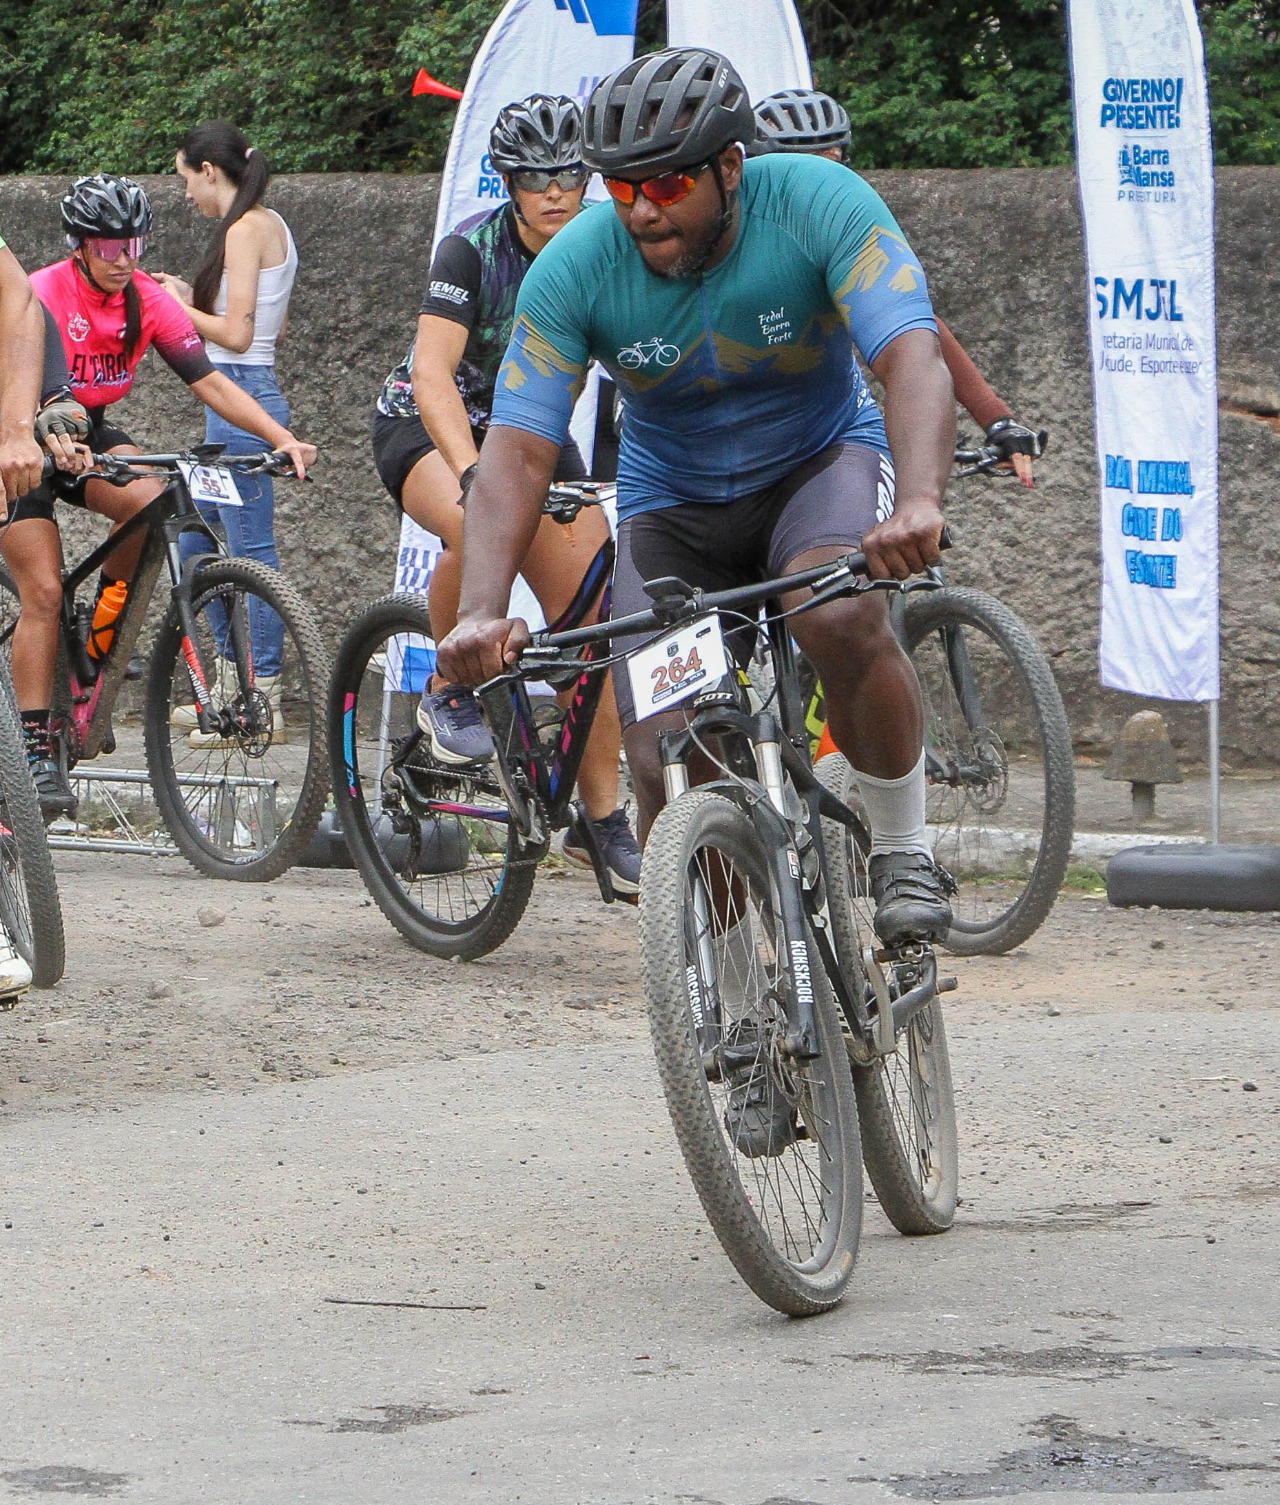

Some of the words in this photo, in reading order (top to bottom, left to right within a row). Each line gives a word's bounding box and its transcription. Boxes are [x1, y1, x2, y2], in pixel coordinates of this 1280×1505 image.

[1102, 77, 1175, 103] GVERNO
[1100, 98, 1183, 130] PESENTE!
[1132, 144, 1170, 166] Barra
[1117, 189, 1176, 204] PRETURA
[428, 280, 469, 302] SEMEL
[1094, 276, 1184, 322] SMJL
[758, 306, 785, 326] Pedal
[761, 320, 791, 336] Barra
[767, 331, 793, 346] Forte
[1103, 331, 1143, 350] retaria
[201, 477, 222, 494] 55
[1160, 507, 1184, 543] DO
[650, 646, 703, 695] 264
[693, 692, 733, 709] SCOTT
[790, 940, 815, 1004] ROCKSHOX
